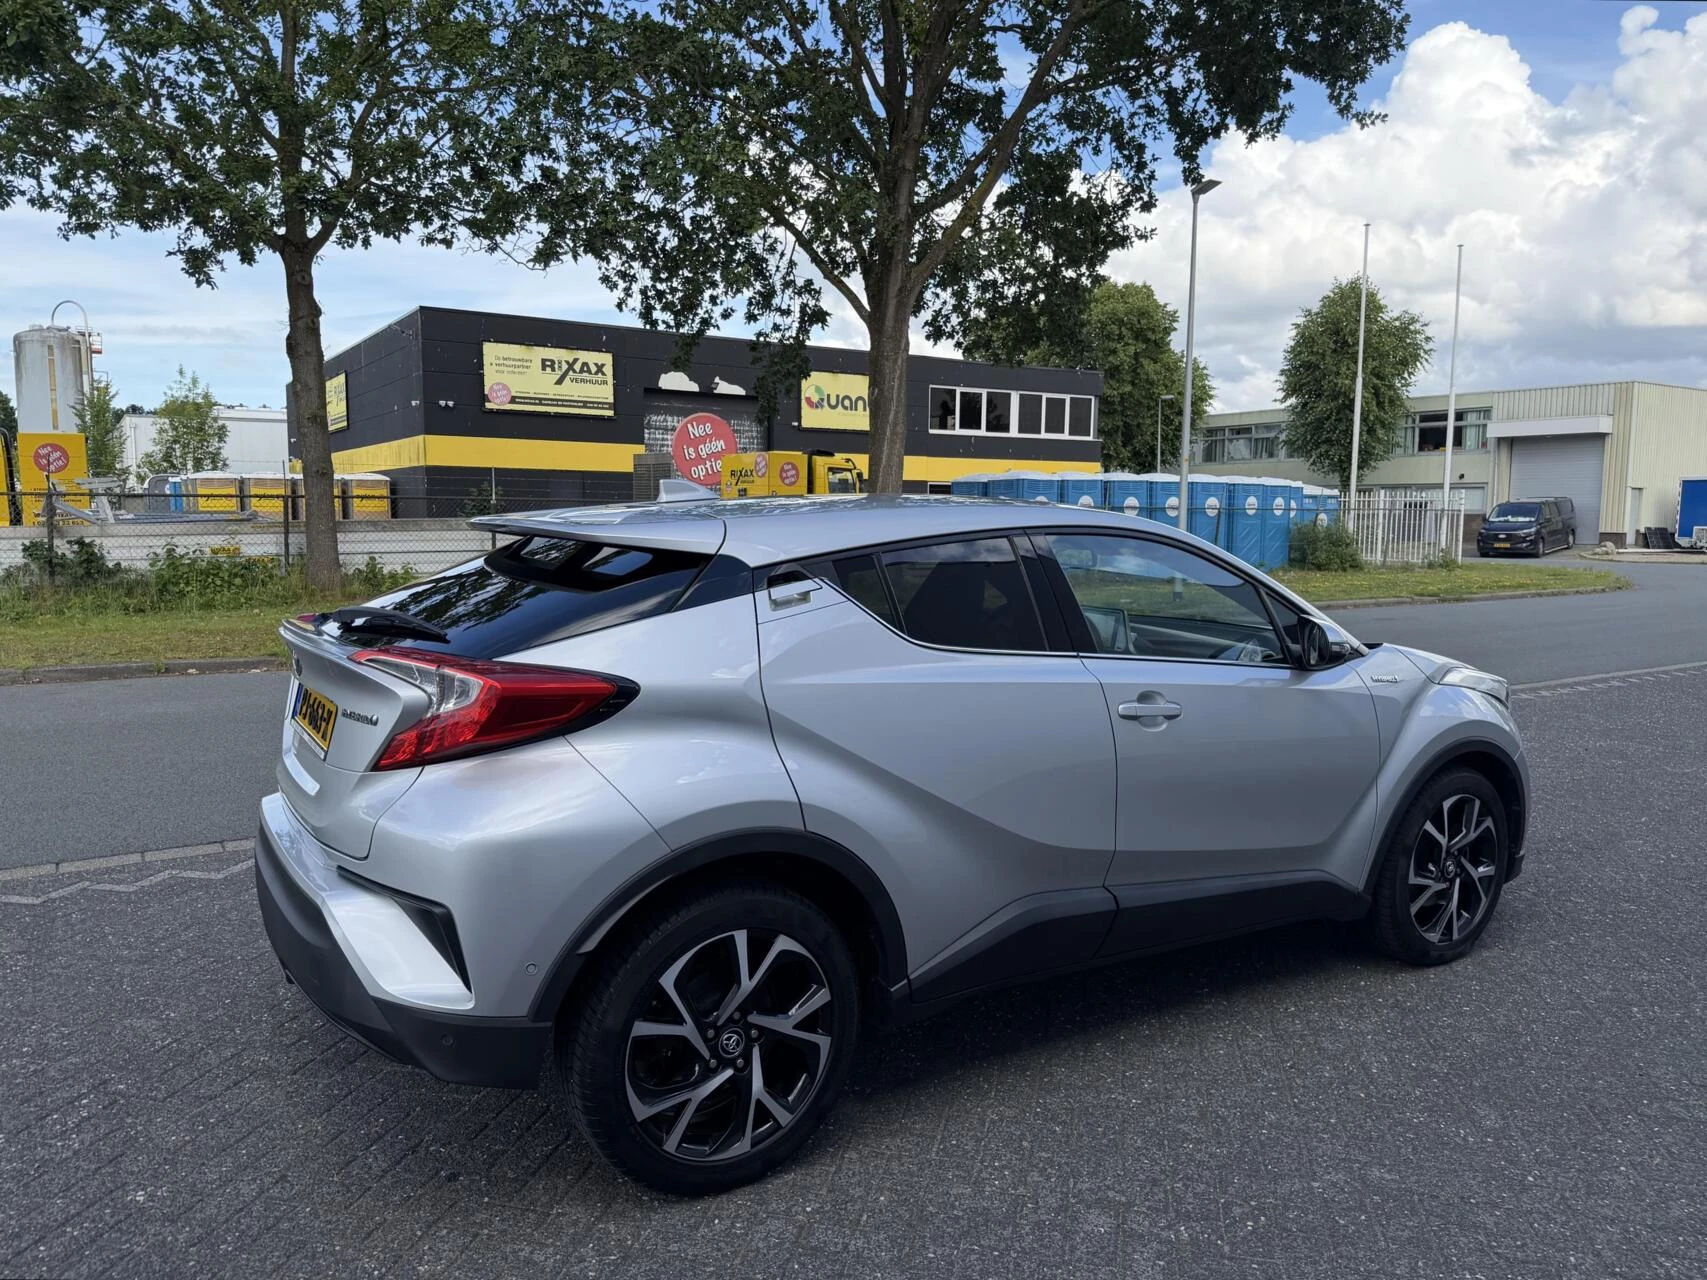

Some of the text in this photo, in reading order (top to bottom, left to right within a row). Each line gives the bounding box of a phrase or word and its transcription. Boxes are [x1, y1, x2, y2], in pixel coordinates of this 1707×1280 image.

[569, 377, 609, 386] VERHUUR
[687, 421, 713, 439] Nee
[683, 437, 726, 460] is géén
[691, 458, 722, 480] optie
